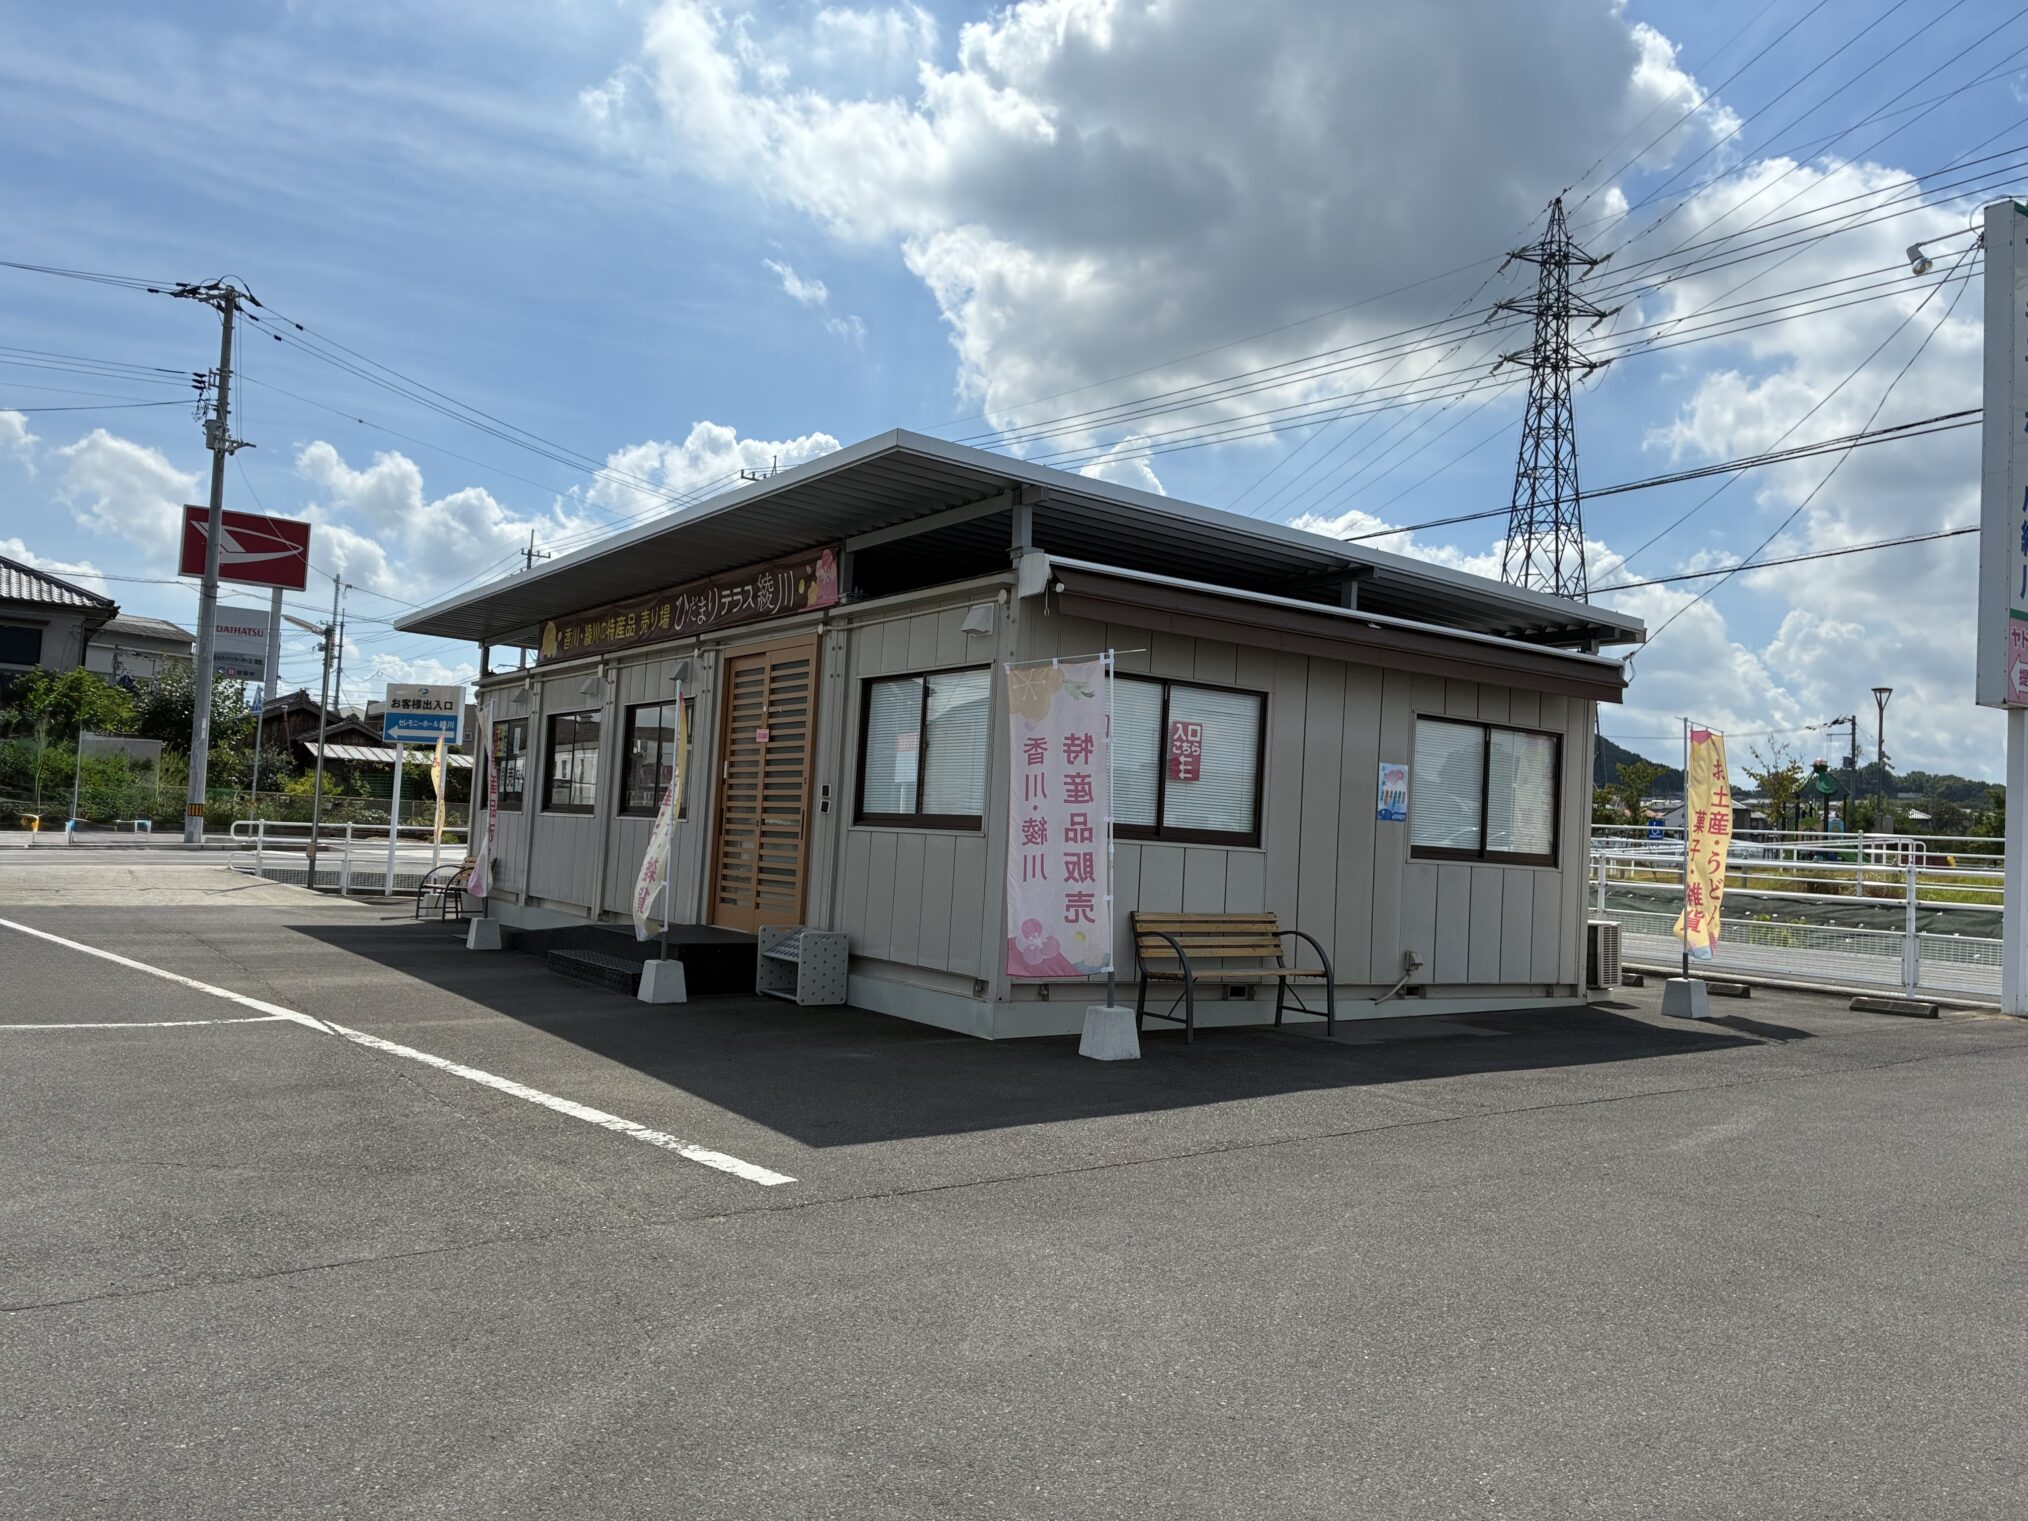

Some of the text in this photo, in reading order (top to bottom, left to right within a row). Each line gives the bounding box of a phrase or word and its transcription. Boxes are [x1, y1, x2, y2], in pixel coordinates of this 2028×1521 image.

[639, 604, 671, 633] 売り場
[674, 570, 794, 631] ひだまりテラス綾川
[216, 625, 264, 637] DAIHATSU
[391, 698, 453, 711] お客様出入口
[1173, 723, 1202, 742] 入口
[1172, 741, 1201, 756] こちら
